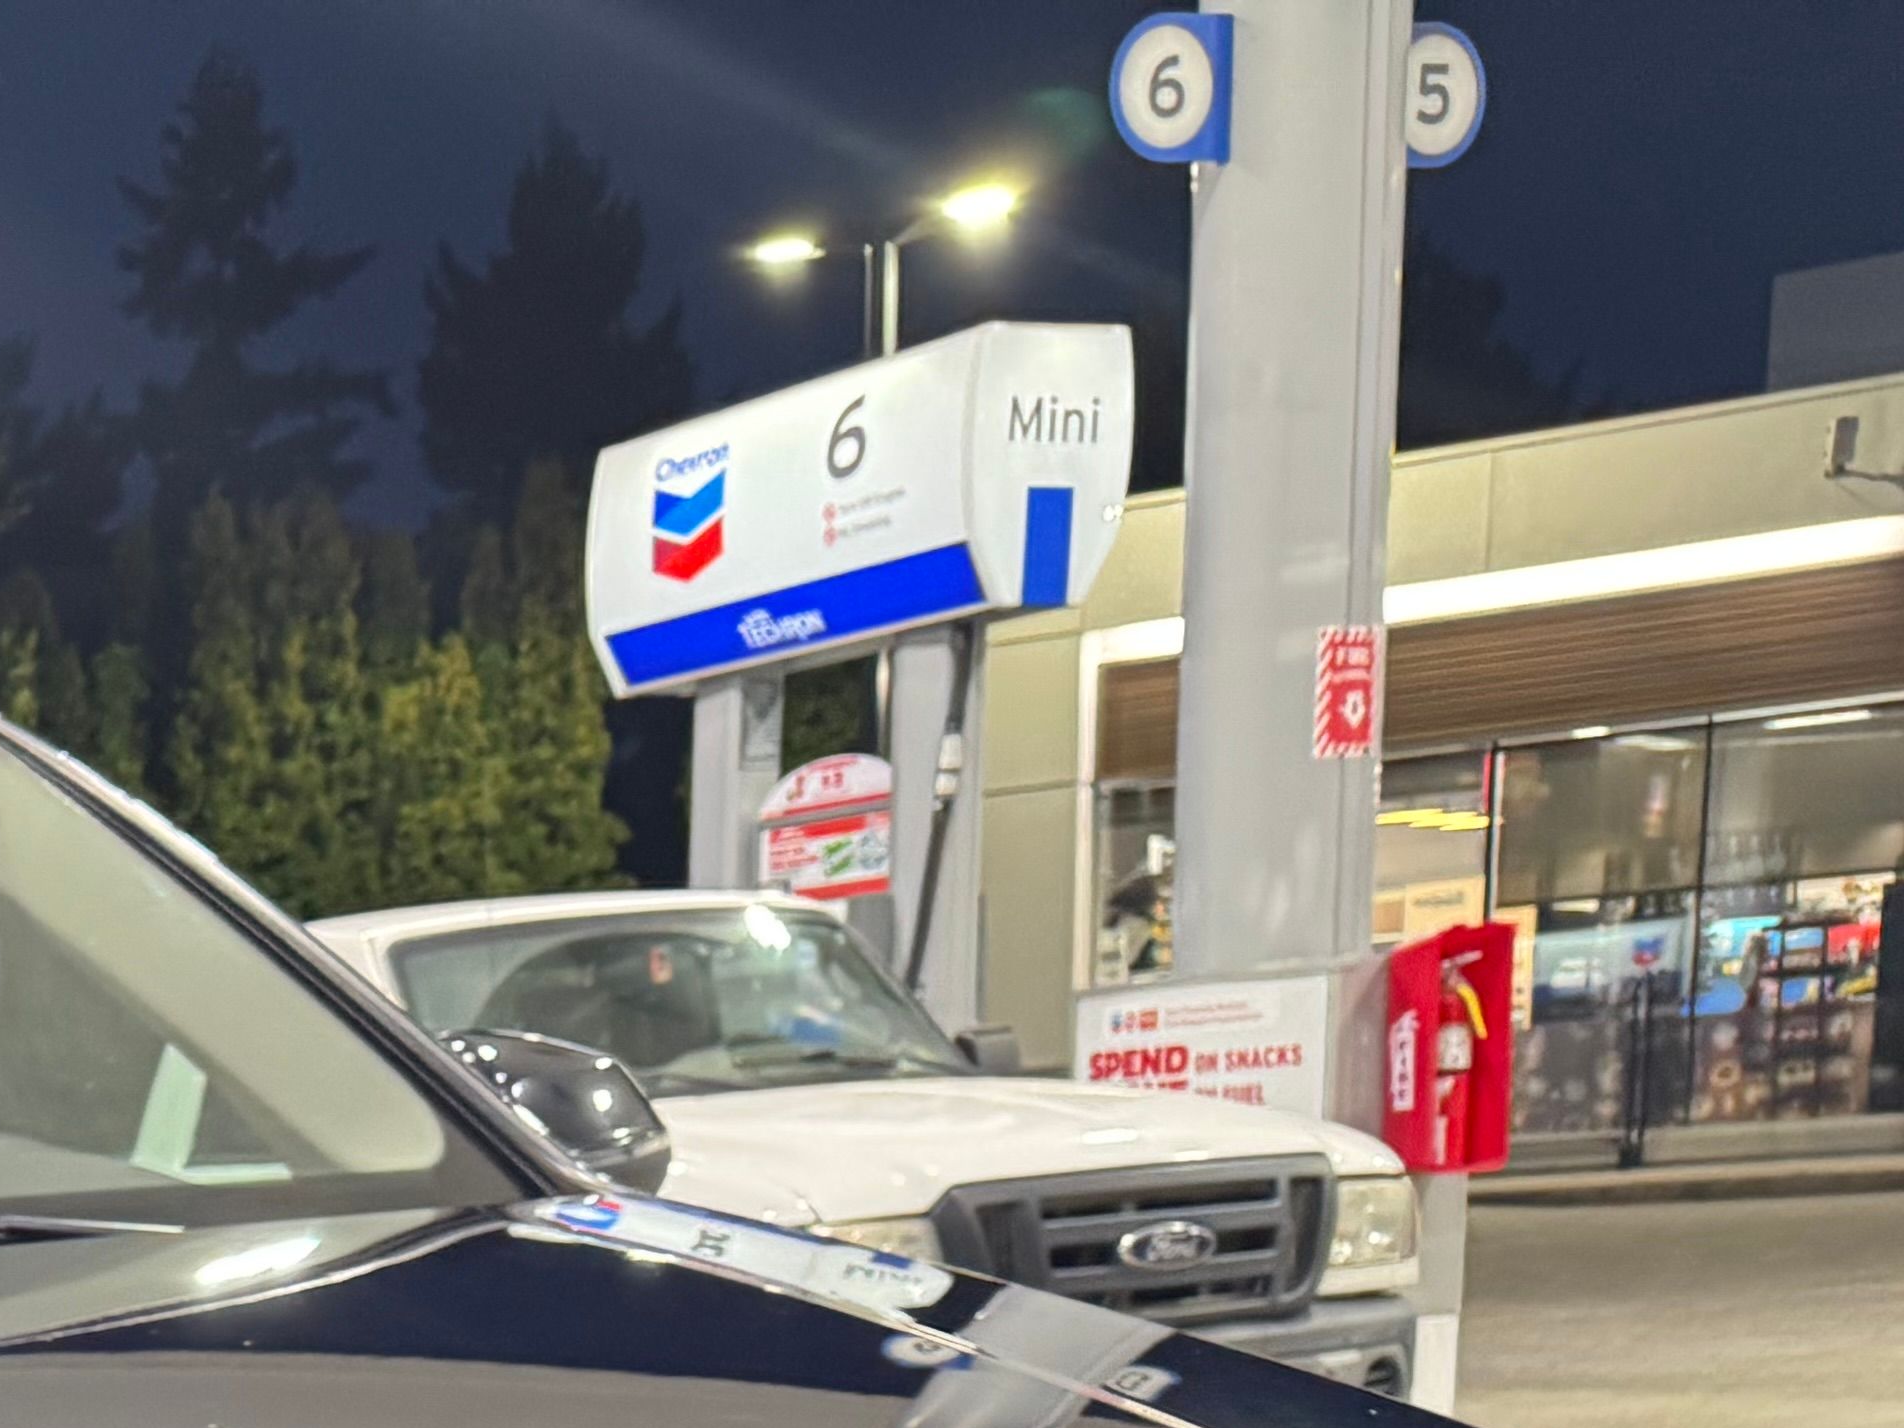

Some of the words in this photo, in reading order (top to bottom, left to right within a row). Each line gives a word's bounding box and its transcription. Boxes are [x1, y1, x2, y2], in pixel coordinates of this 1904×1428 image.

[1148, 53, 1186, 119] 6
[1416, 62, 1451, 126] 5
[825, 394, 866, 480] 6
[1007, 395, 1101, 445] Mini
[655, 442, 730, 482] Chevron
[1088, 1044, 1189, 1082] SPEND
[1194, 1052, 1218, 1073] ON
[1225, 1043, 1303, 1071] SNACKS
[1145, 1232, 1202, 1262] Ford
